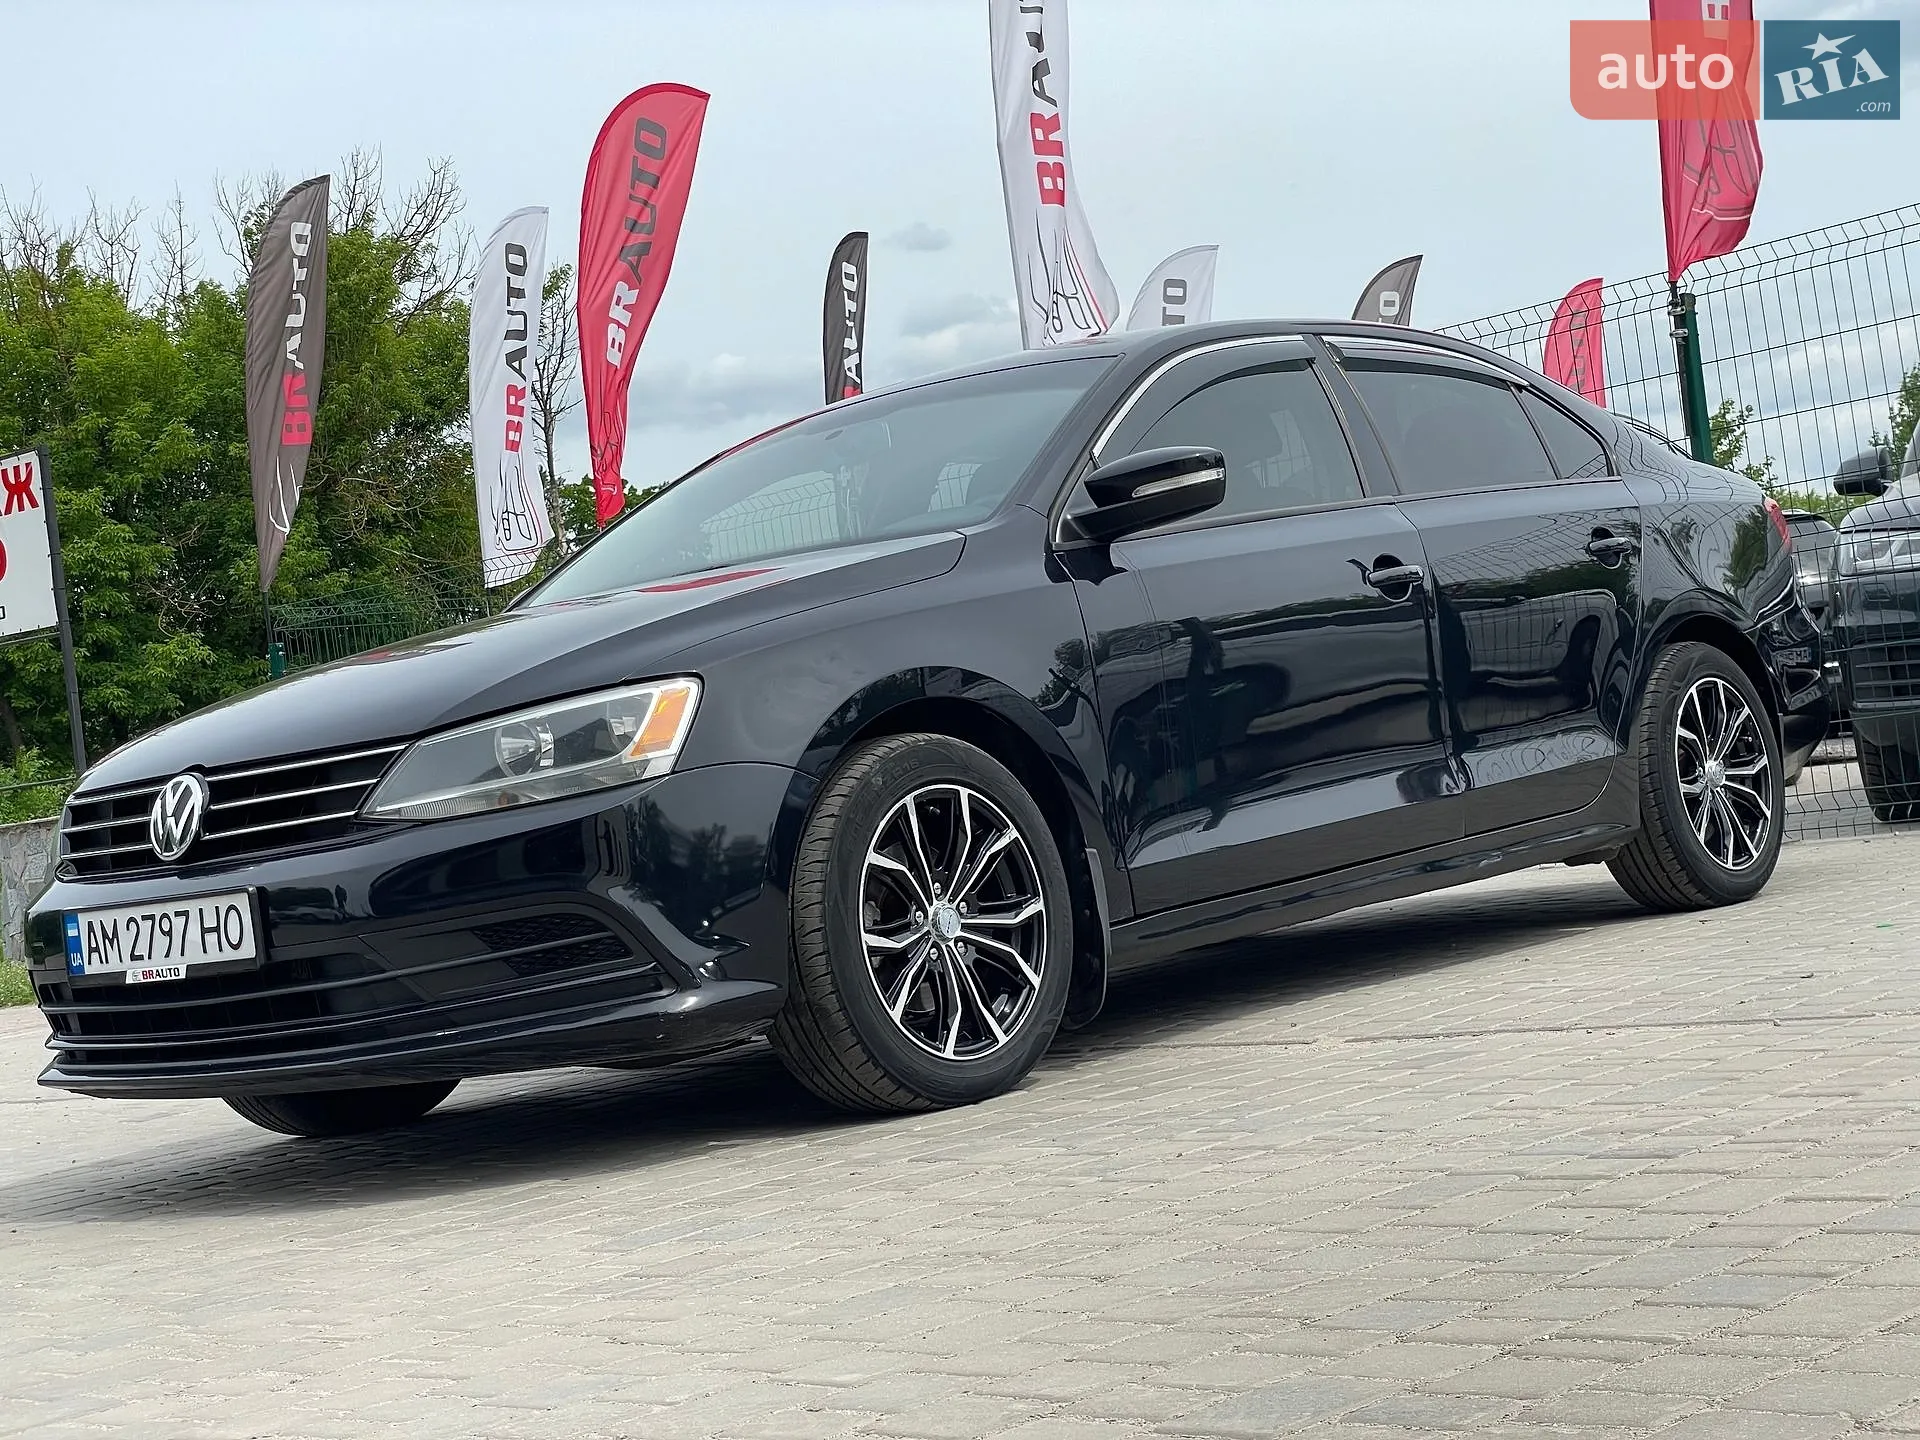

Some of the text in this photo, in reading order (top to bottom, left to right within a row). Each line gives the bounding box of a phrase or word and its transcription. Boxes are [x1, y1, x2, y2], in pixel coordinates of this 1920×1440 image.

[1019, 0, 1067, 208] BRAU
[280, 221, 314, 445] BRAUTO
[606, 117, 667, 369] BRAUTO
[504, 242, 528, 453] BRAUTO
[70, 952, 84, 967] UA
[87, 903, 244, 966] AM 2797 HO
[141, 967, 181, 980] BRAUTO
